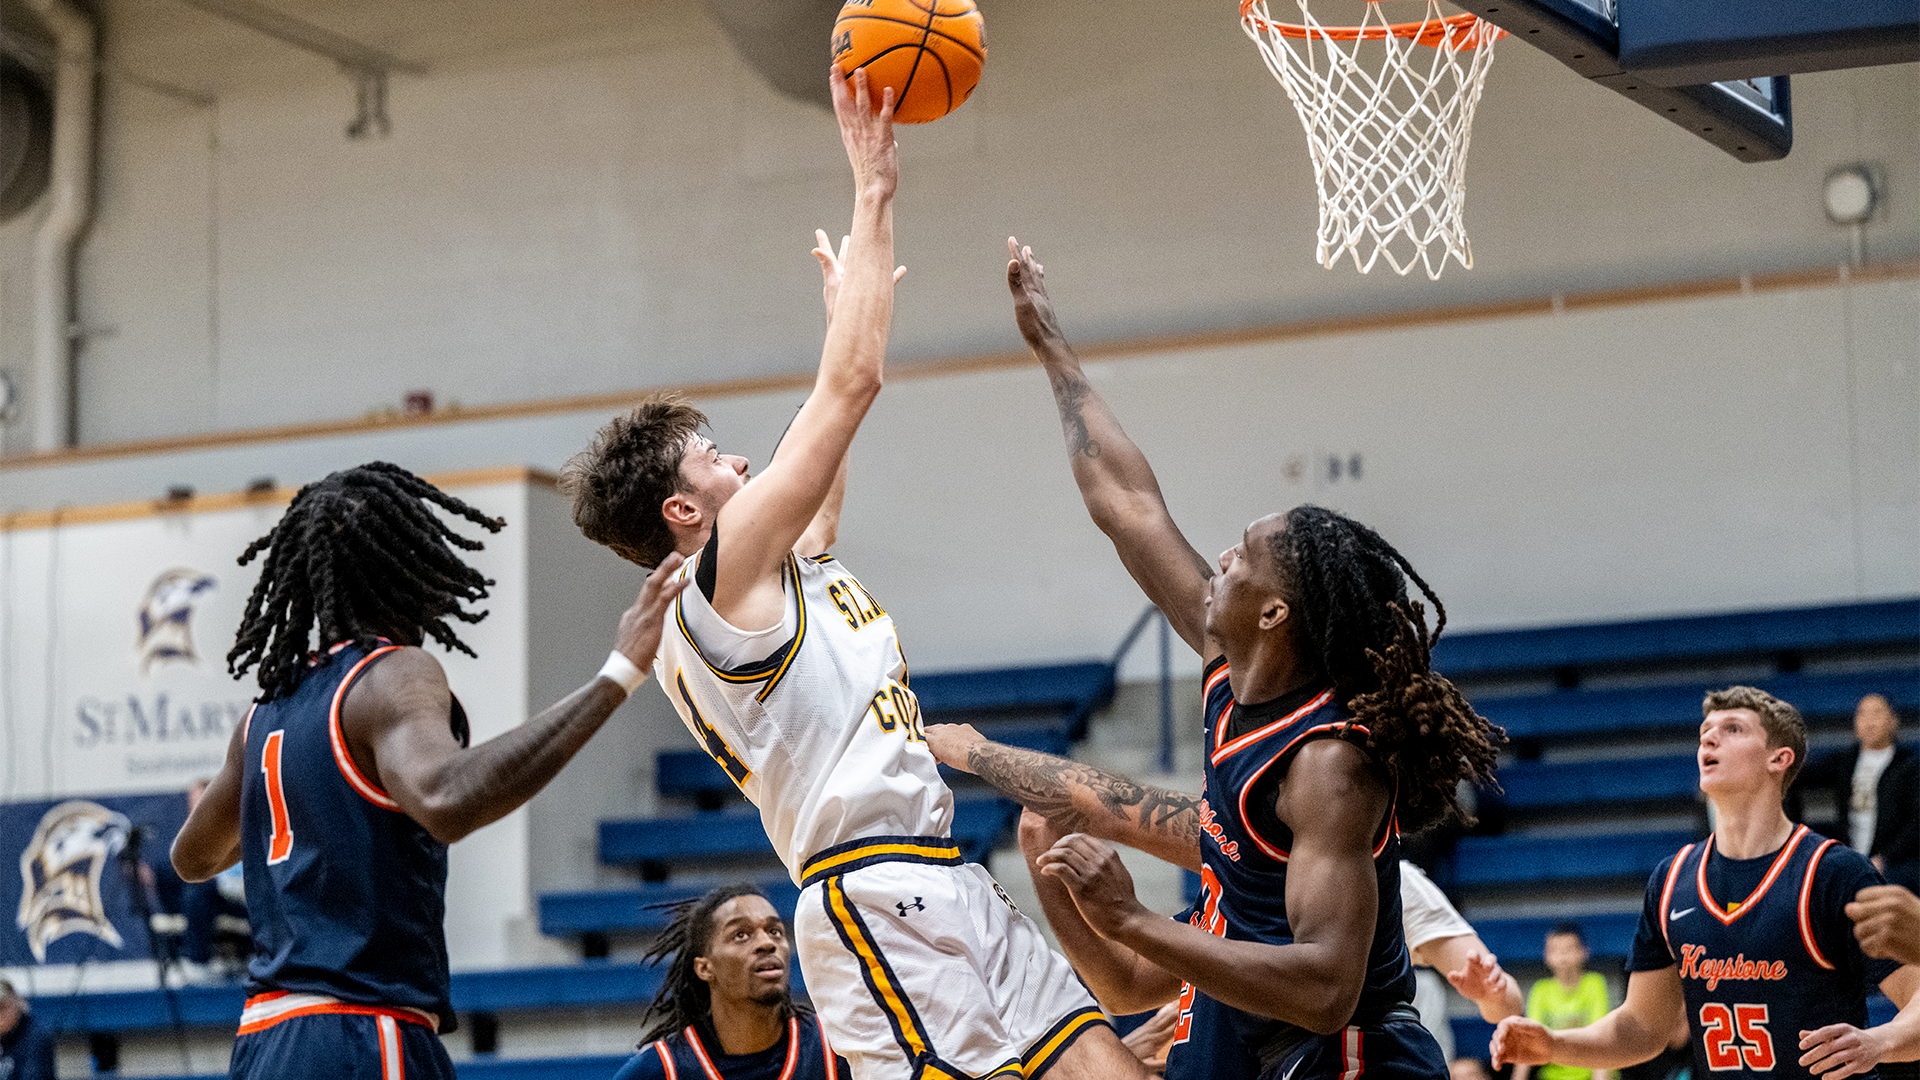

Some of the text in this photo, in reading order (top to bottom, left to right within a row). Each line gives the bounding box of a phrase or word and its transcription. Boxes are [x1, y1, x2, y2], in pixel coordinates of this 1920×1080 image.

[261, 729, 294, 866] 1
[1679, 943, 1787, 992] Keystone
[1699, 1002, 1776, 1072] 25
